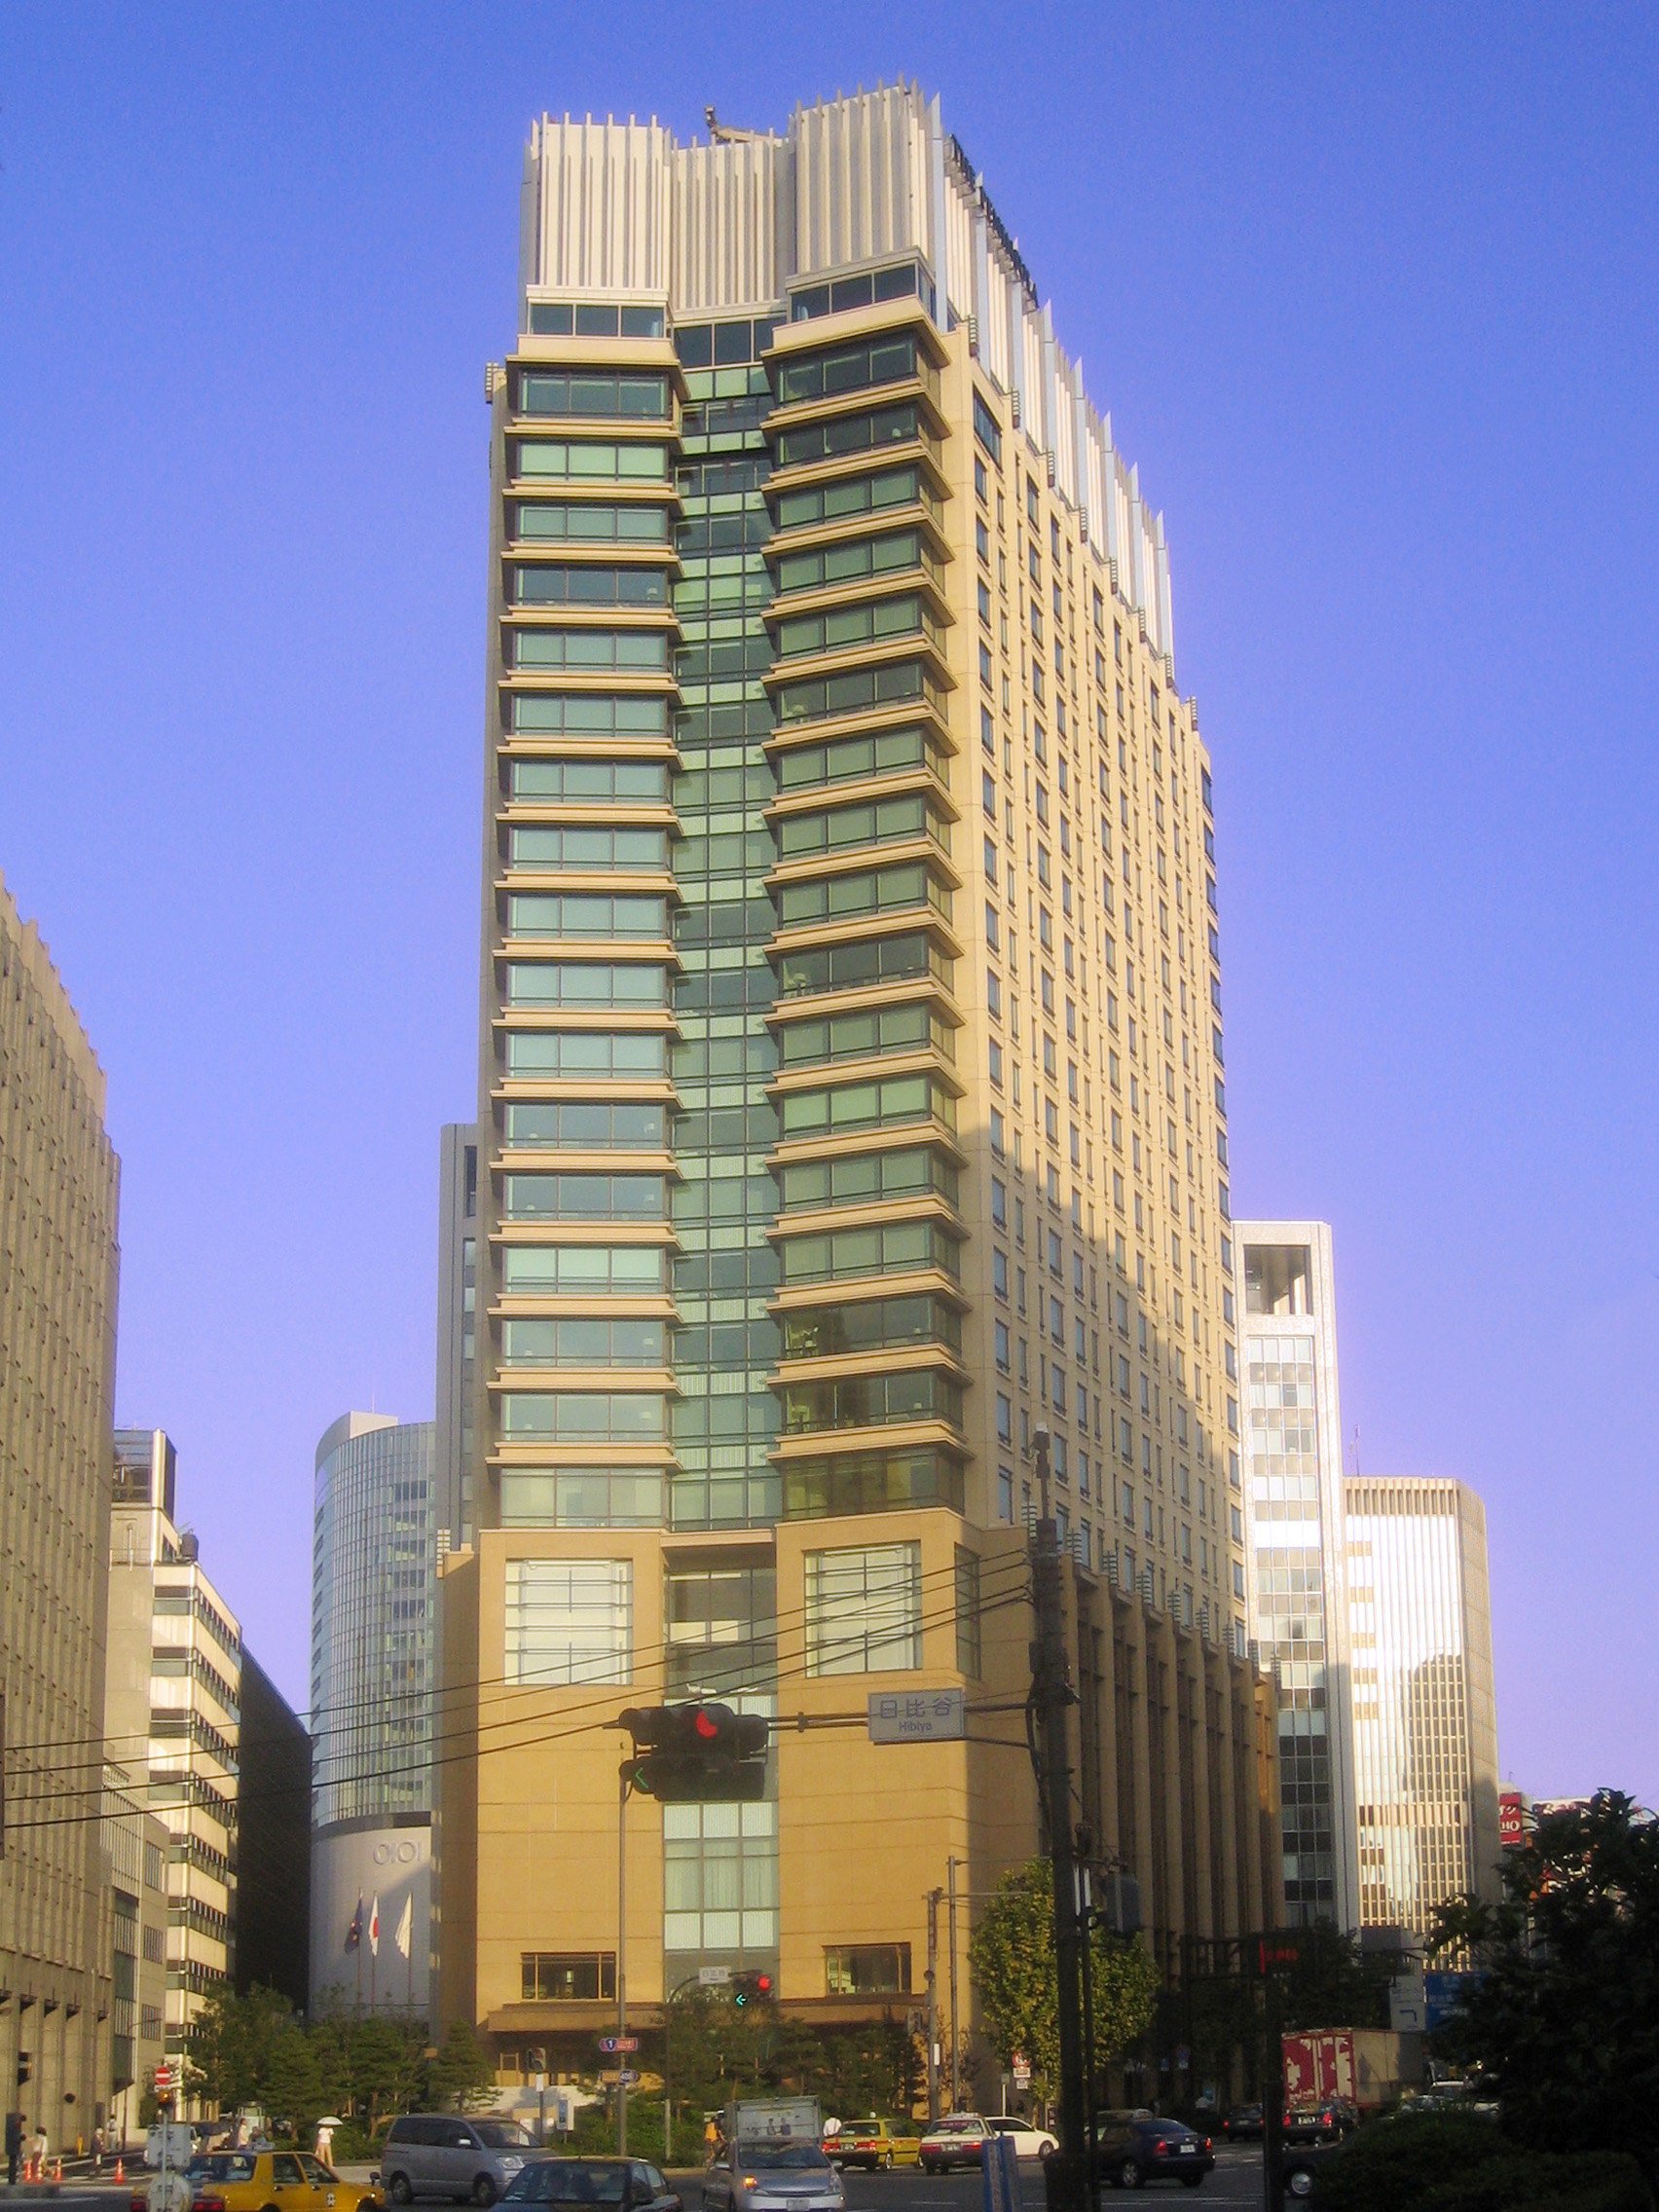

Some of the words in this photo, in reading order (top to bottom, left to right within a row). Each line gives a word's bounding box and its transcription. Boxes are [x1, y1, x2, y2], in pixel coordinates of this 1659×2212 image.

[880, 1697, 951, 1719] 日比谷
[899, 1720, 933, 1732] Hibiya
